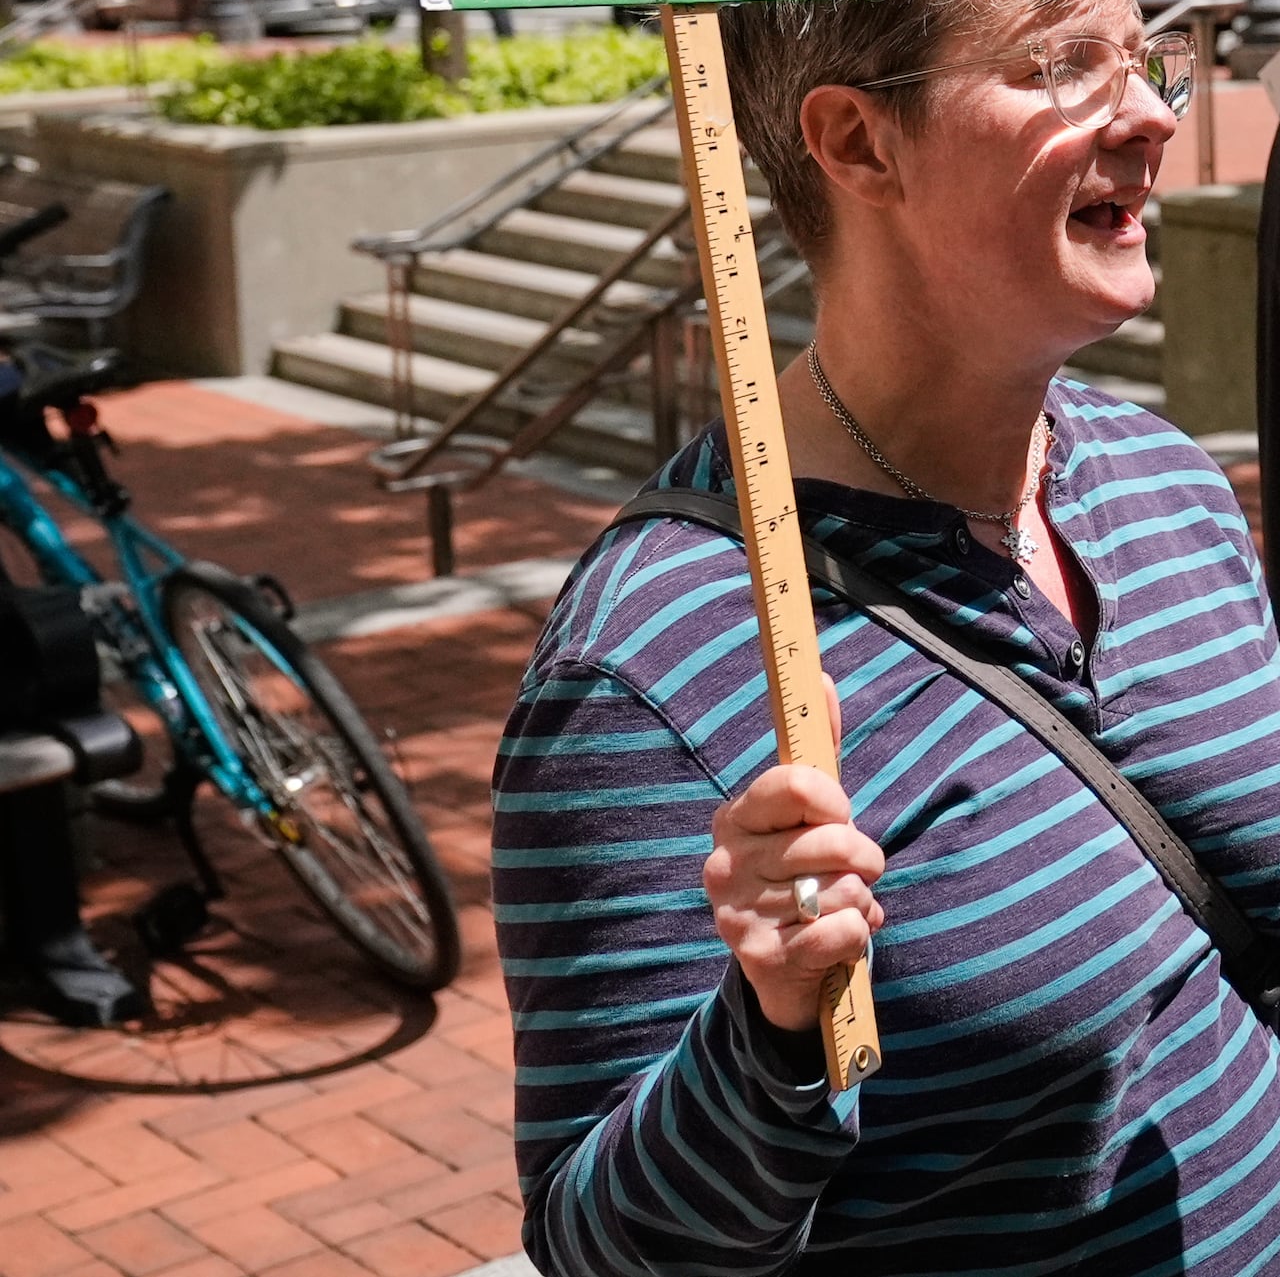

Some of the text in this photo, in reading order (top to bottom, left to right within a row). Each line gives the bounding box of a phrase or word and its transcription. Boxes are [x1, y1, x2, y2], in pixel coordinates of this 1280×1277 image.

[696, 64, 708, 88] 16
[705, 127, 718, 152] 15
[715, 191, 728, 215] 14
[726, 253, 738, 278] 13
[737, 316, 749, 341] 12
[746, 381, 759, 404] 11
[756, 441, 769, 468] 10
[768, 521, 778, 532] 9
[778, 582, 789, 594] 8
[788, 647, 799, 658] 7
[800, 706, 808, 717] 6
